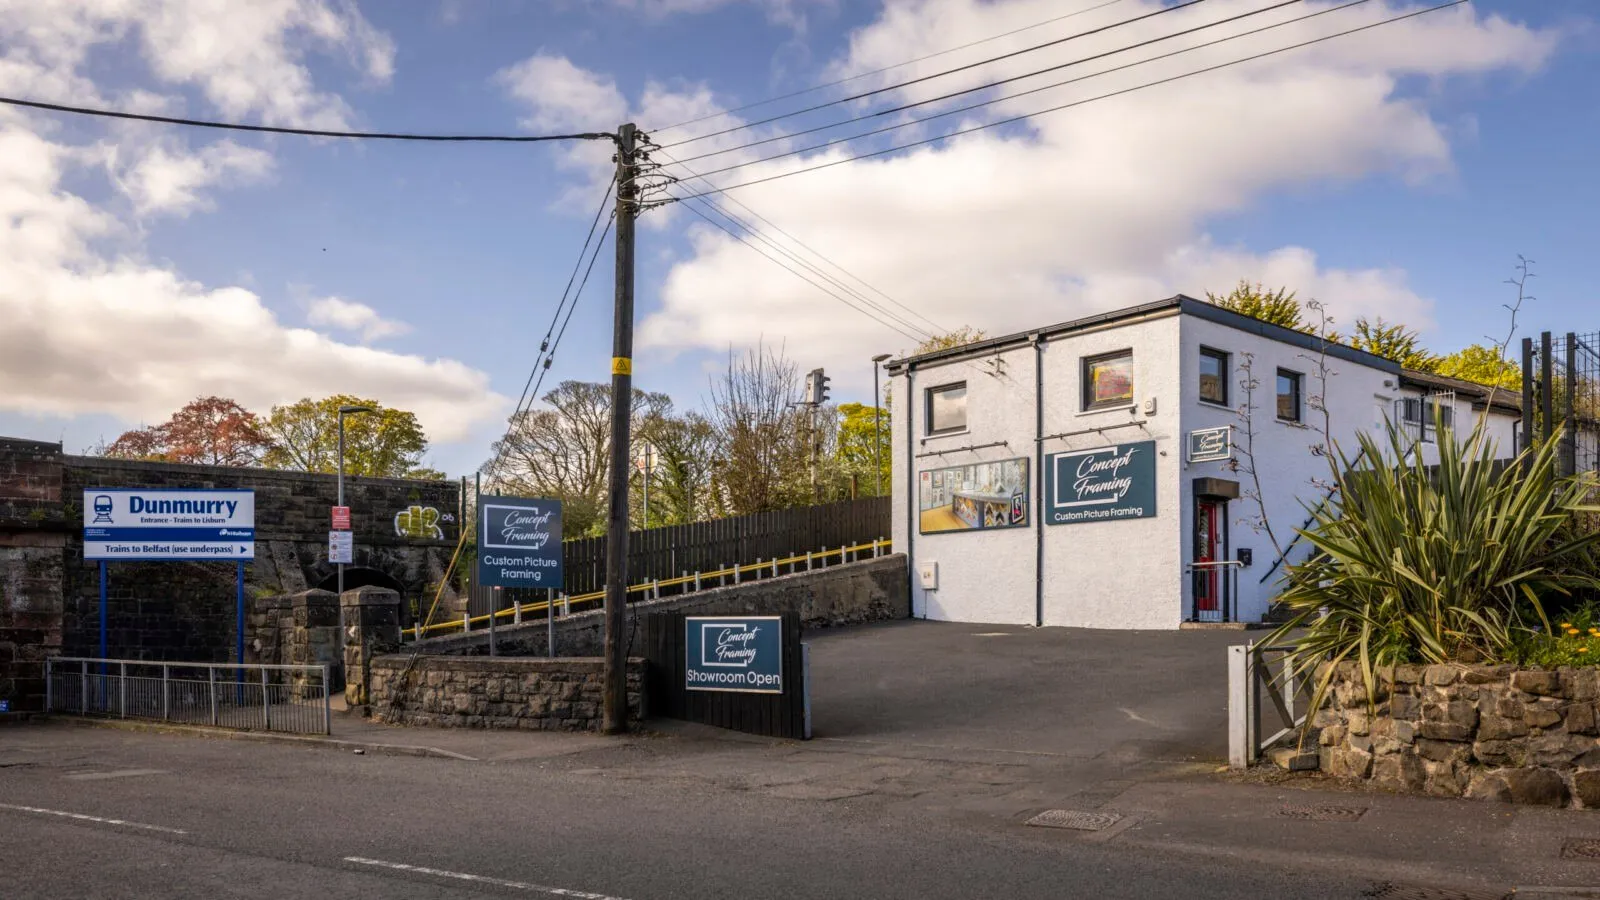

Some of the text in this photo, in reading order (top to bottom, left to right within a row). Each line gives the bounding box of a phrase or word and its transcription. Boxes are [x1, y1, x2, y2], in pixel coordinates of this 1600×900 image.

[1077, 448, 1143, 478] Concept
[1073, 476, 1132, 500] Framing
[130, 496, 238, 518] Dunmurry
[1055, 507, 1142, 520] Custom Picture Framing
[504, 510, 556, 530] Concept
[501, 526, 549, 546] Framing
[172, 545, 188, 554] (use
[190, 545, 234, 554] underpass)
[484, 556, 558, 567] Custom Picture
[501, 568, 542, 581] Framing
[718, 626, 763, 647] Concept
[716, 644, 756, 664] Framing
[687, 669, 780, 686] Showroom Open
